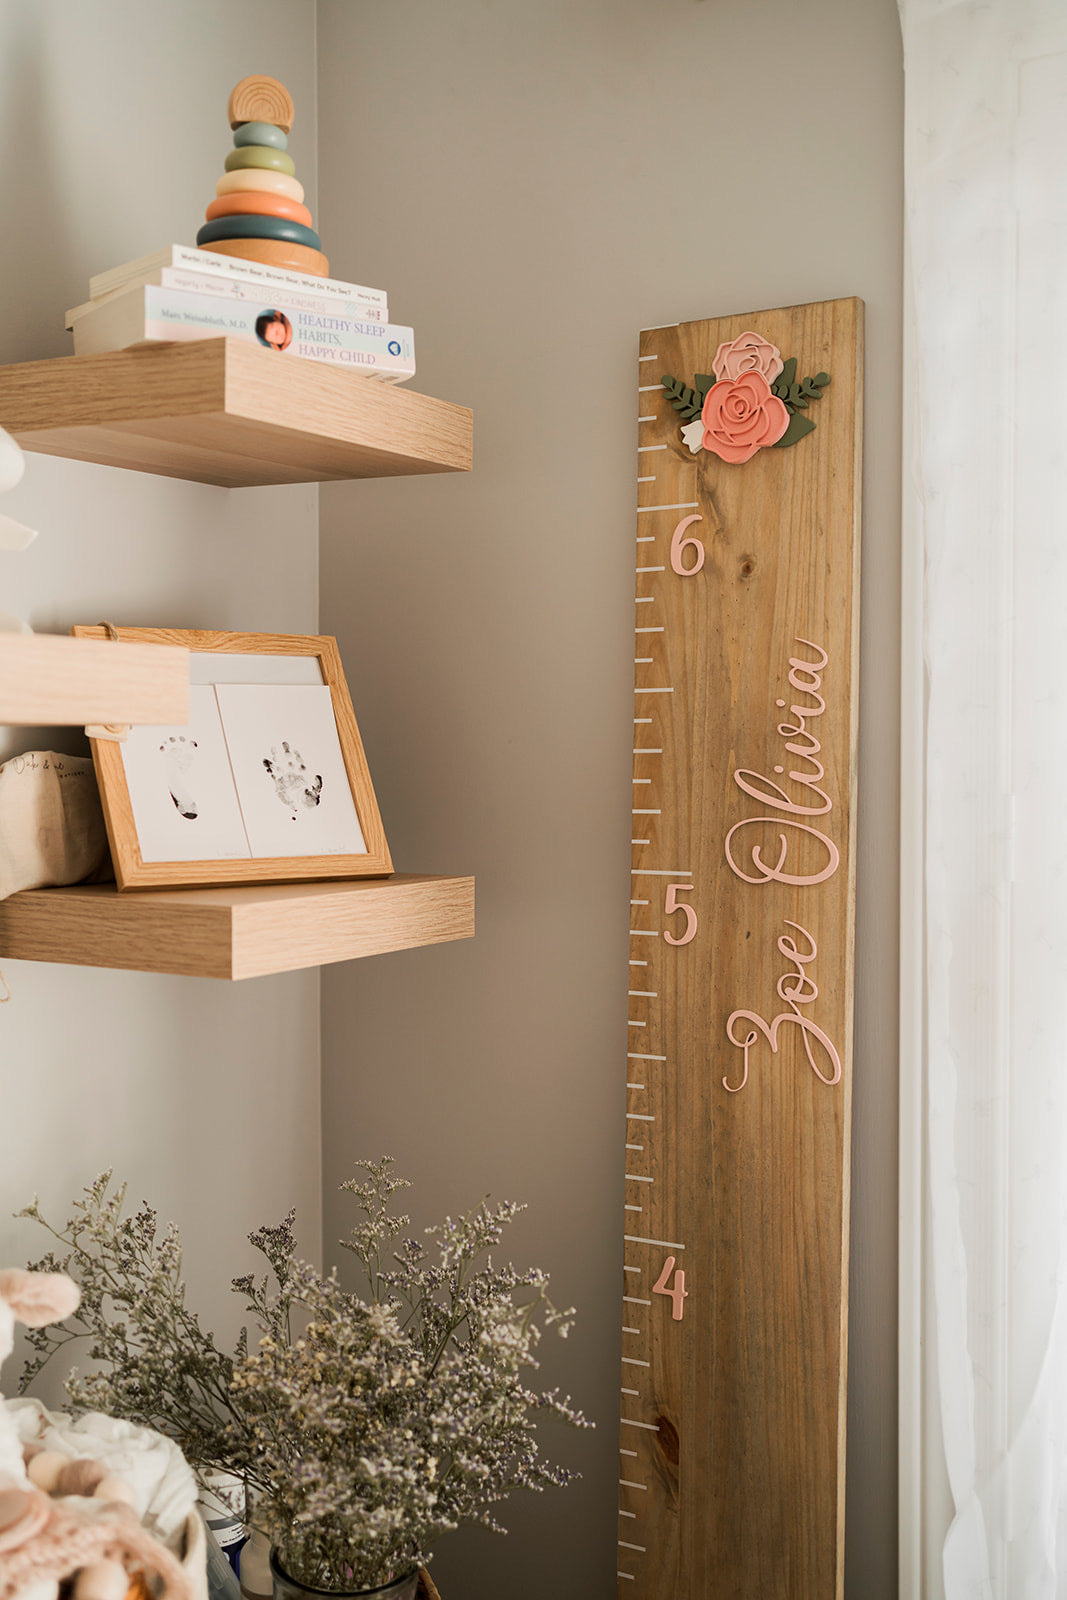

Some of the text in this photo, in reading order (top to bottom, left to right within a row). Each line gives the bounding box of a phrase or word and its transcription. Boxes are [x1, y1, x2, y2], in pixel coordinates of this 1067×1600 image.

[229, 264, 248, 273] Brown
[266, 272, 284, 281] Brown
[302, 280, 316, 288] What
[317, 282, 325, 290] Do
[326, 285, 337, 293] You
[229, 320, 248, 329] M.D.
[298, 313, 352, 332] HEALTHY
[354, 323, 386, 337] SLEEP
[298, 329, 342, 346] HABITS,
[298, 344, 376, 365] HAPPY CHILD
[669, 513, 706, 577] 6
[724, 636, 840, 886] Olivia
[662, 883, 698, 946] 5
[651, 1255, 689, 1321] 4
